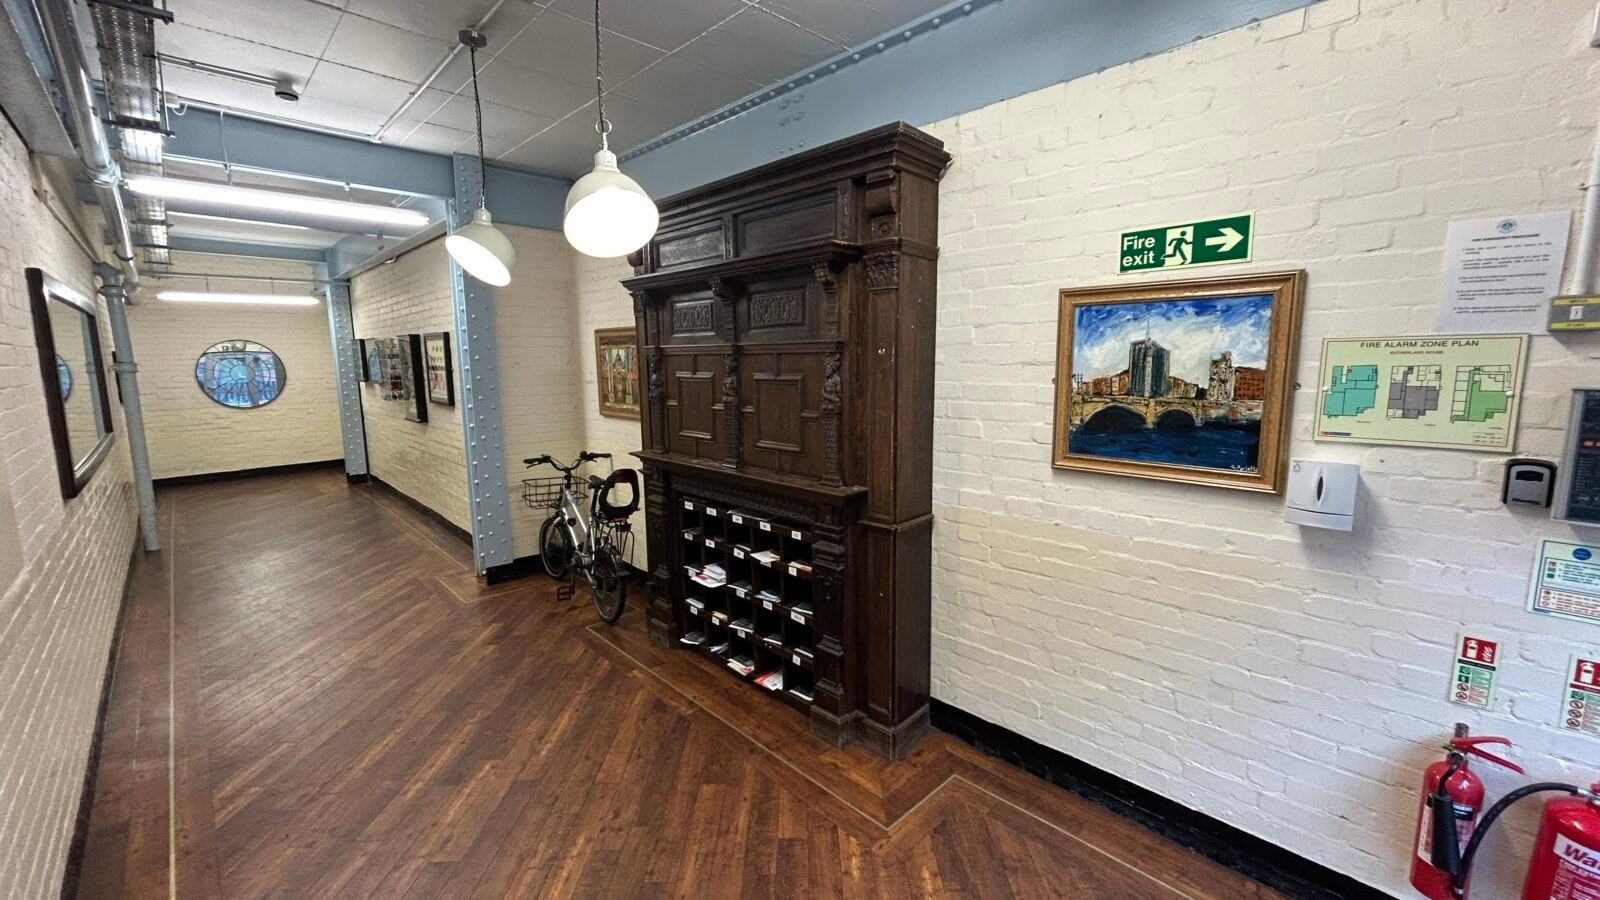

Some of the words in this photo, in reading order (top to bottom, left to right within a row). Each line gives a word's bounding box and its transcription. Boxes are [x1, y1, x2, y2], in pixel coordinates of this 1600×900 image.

[1123, 236, 1155, 251] Fire
[1122, 251, 1155, 267] exit
[1420, 340, 1449, 348] ZONE
